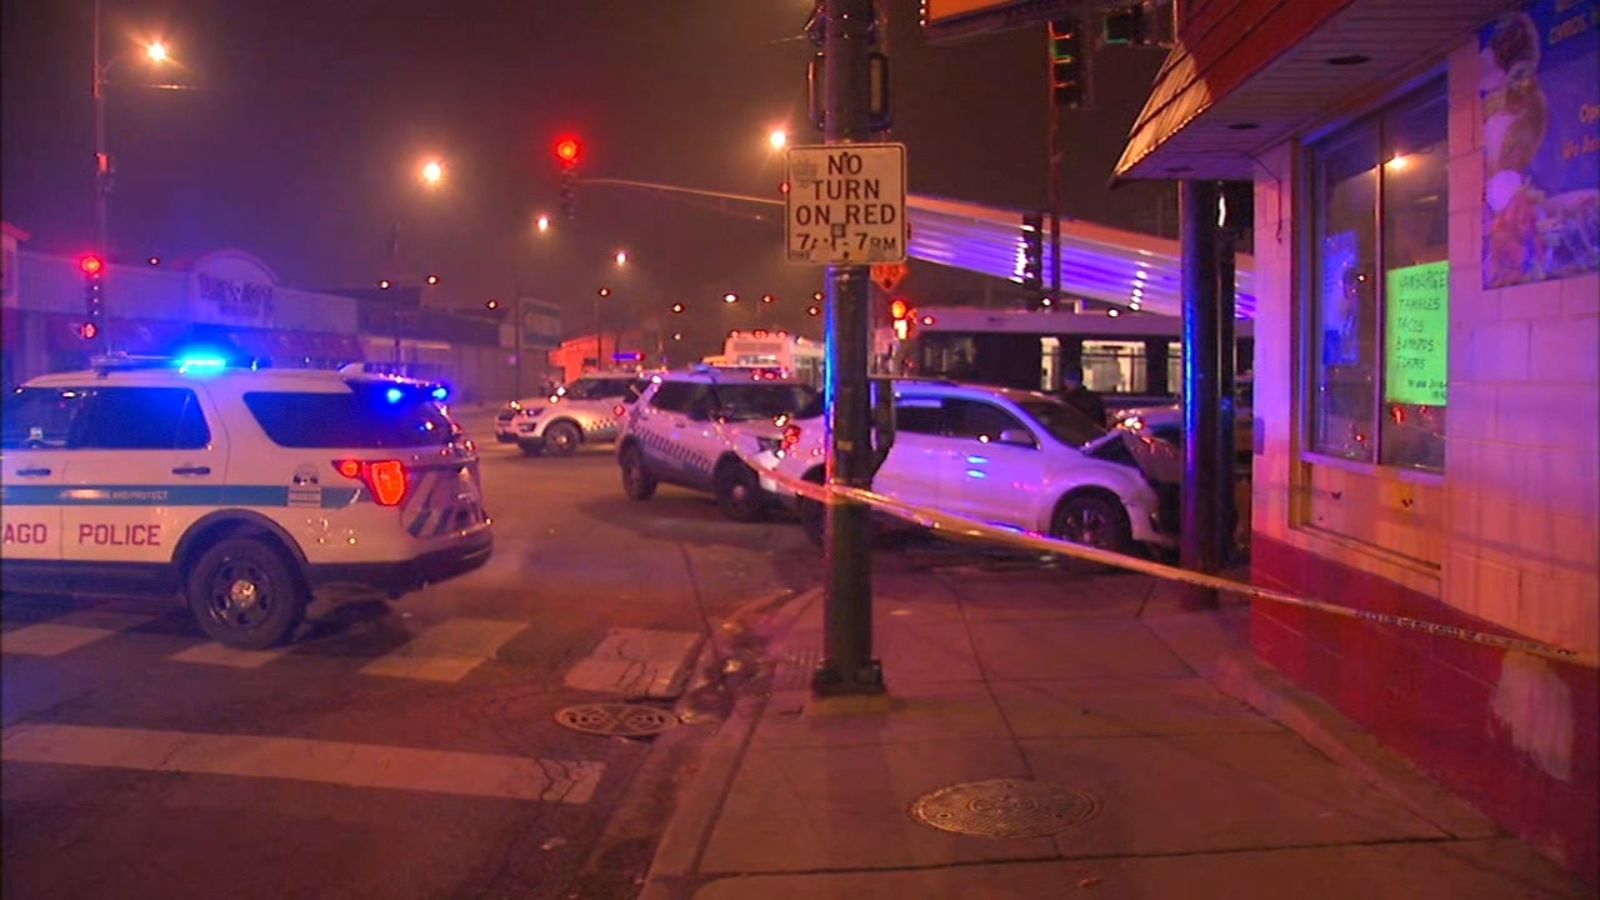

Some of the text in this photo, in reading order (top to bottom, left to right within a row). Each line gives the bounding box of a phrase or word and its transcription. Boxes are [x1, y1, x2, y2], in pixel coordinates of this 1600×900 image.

[828, 154, 863, 175] NO
[811, 179, 880, 200] TURN
[795, 204, 896, 226] ON RED
[4, 523, 161, 546] AGO POLICE
